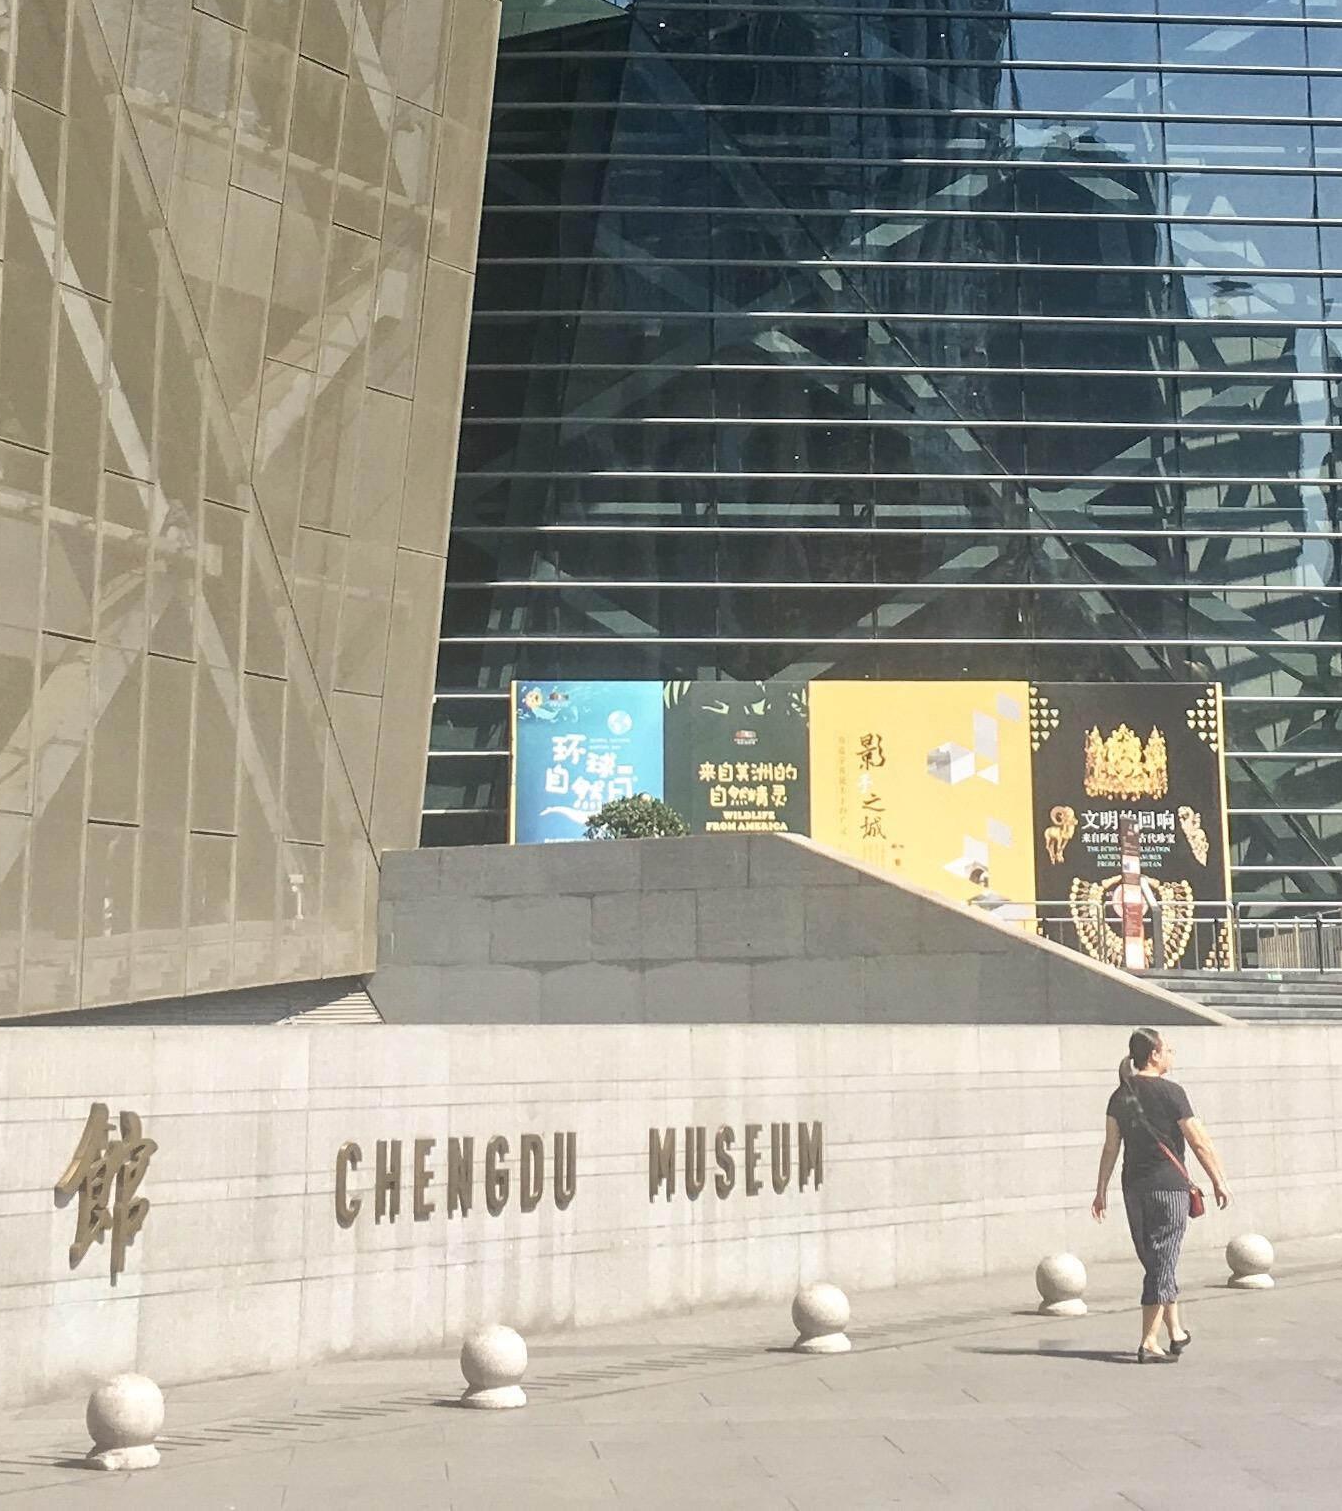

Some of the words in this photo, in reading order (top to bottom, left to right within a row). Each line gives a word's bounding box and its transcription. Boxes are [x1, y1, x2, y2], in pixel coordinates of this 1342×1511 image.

[698, 761, 798, 782] 来自美洲的
[710, 784, 788, 807] 自然精灵
[722, 811, 775, 820] WILDLIFE
[706, 822, 736, 831] FROM
[737, 822, 788, 831] AMERICA
[335, 1132, 576, 1228] CHENGDU
[648, 1121, 823, 1203] MUSEUM
